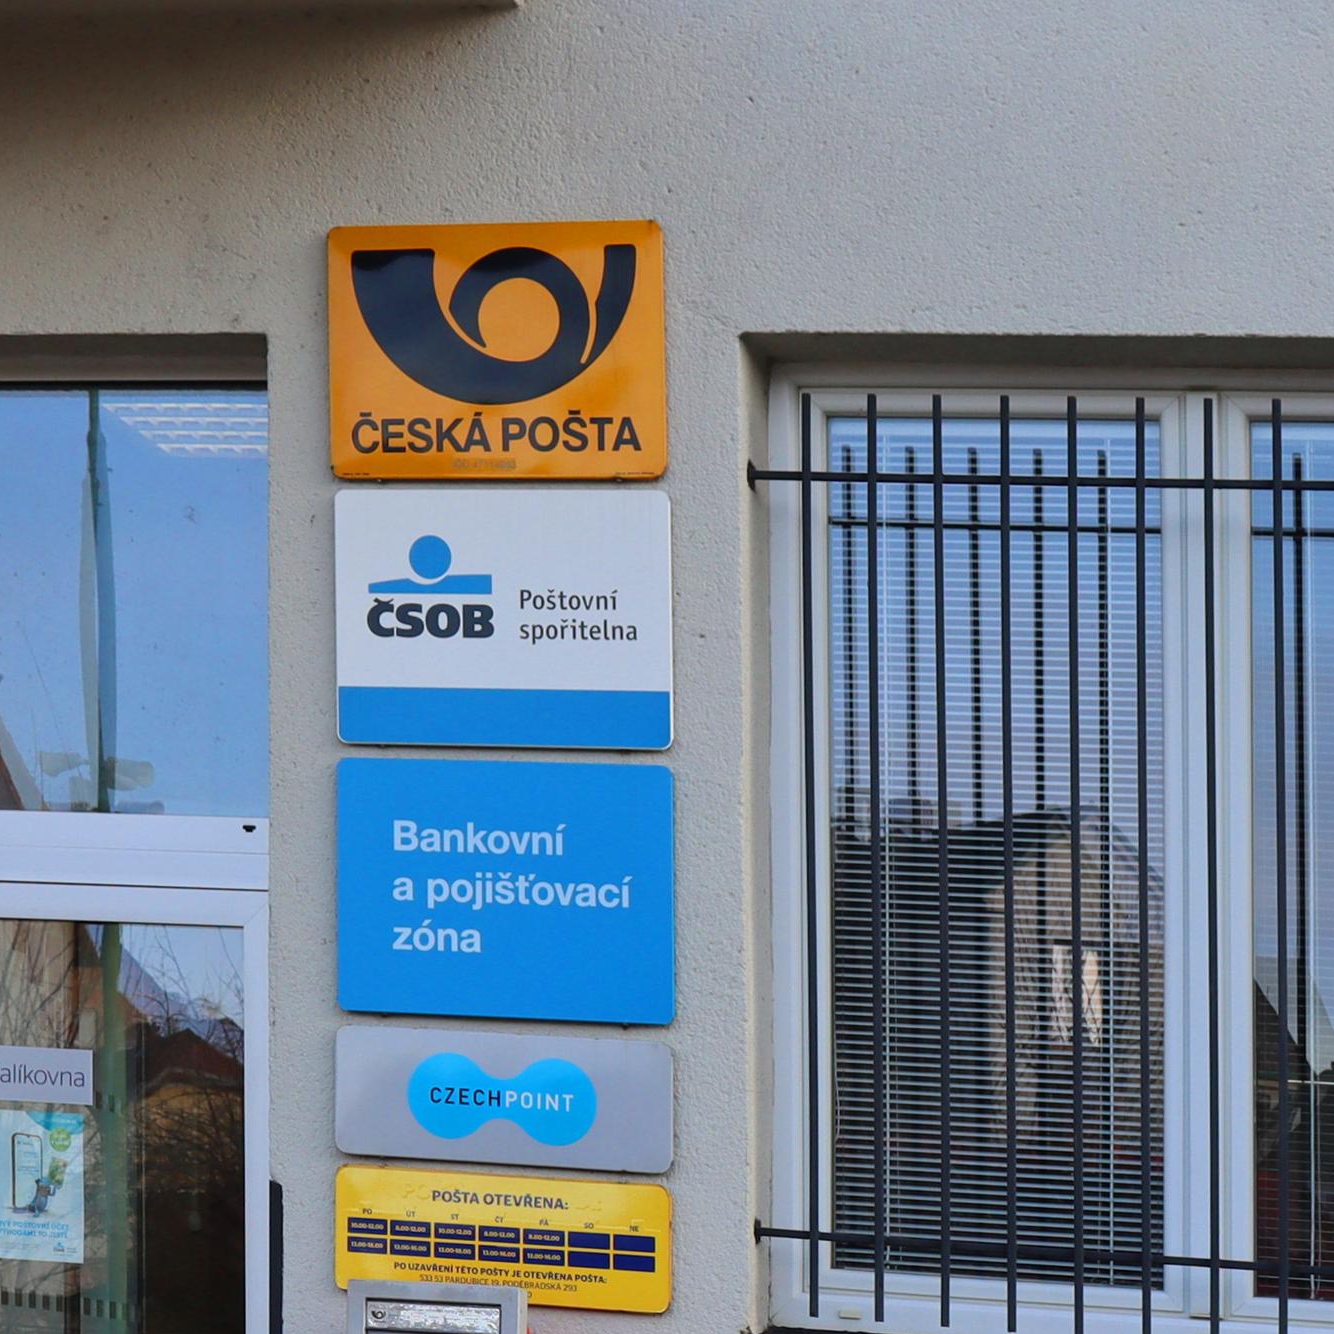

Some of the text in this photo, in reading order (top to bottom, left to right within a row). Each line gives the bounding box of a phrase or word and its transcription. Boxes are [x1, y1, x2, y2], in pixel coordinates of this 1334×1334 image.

[351, 409, 642, 454] ČESKÁ POŠTA
[519, 588, 618, 611] Poštovní
[367, 597, 495, 639] ČSOB
[520, 618, 638, 645] spořitelna
[392, 820, 567, 857] Bankovní
[392, 871, 633, 910] a pojišťovací
[392, 919, 482, 954] zóna
[432, 1189, 569, 1210] POŠTA OTEVŘENA:
[394, 1261, 607, 1284] PO UZAVŘENÍ TÉTO POŠTY JE OTEVŘENA POŠTA:
[419, 1274, 433, 1282] 533
[434, 1275, 444, 1283] 53
[445, 1276, 490, 1286] PARDUBICE
